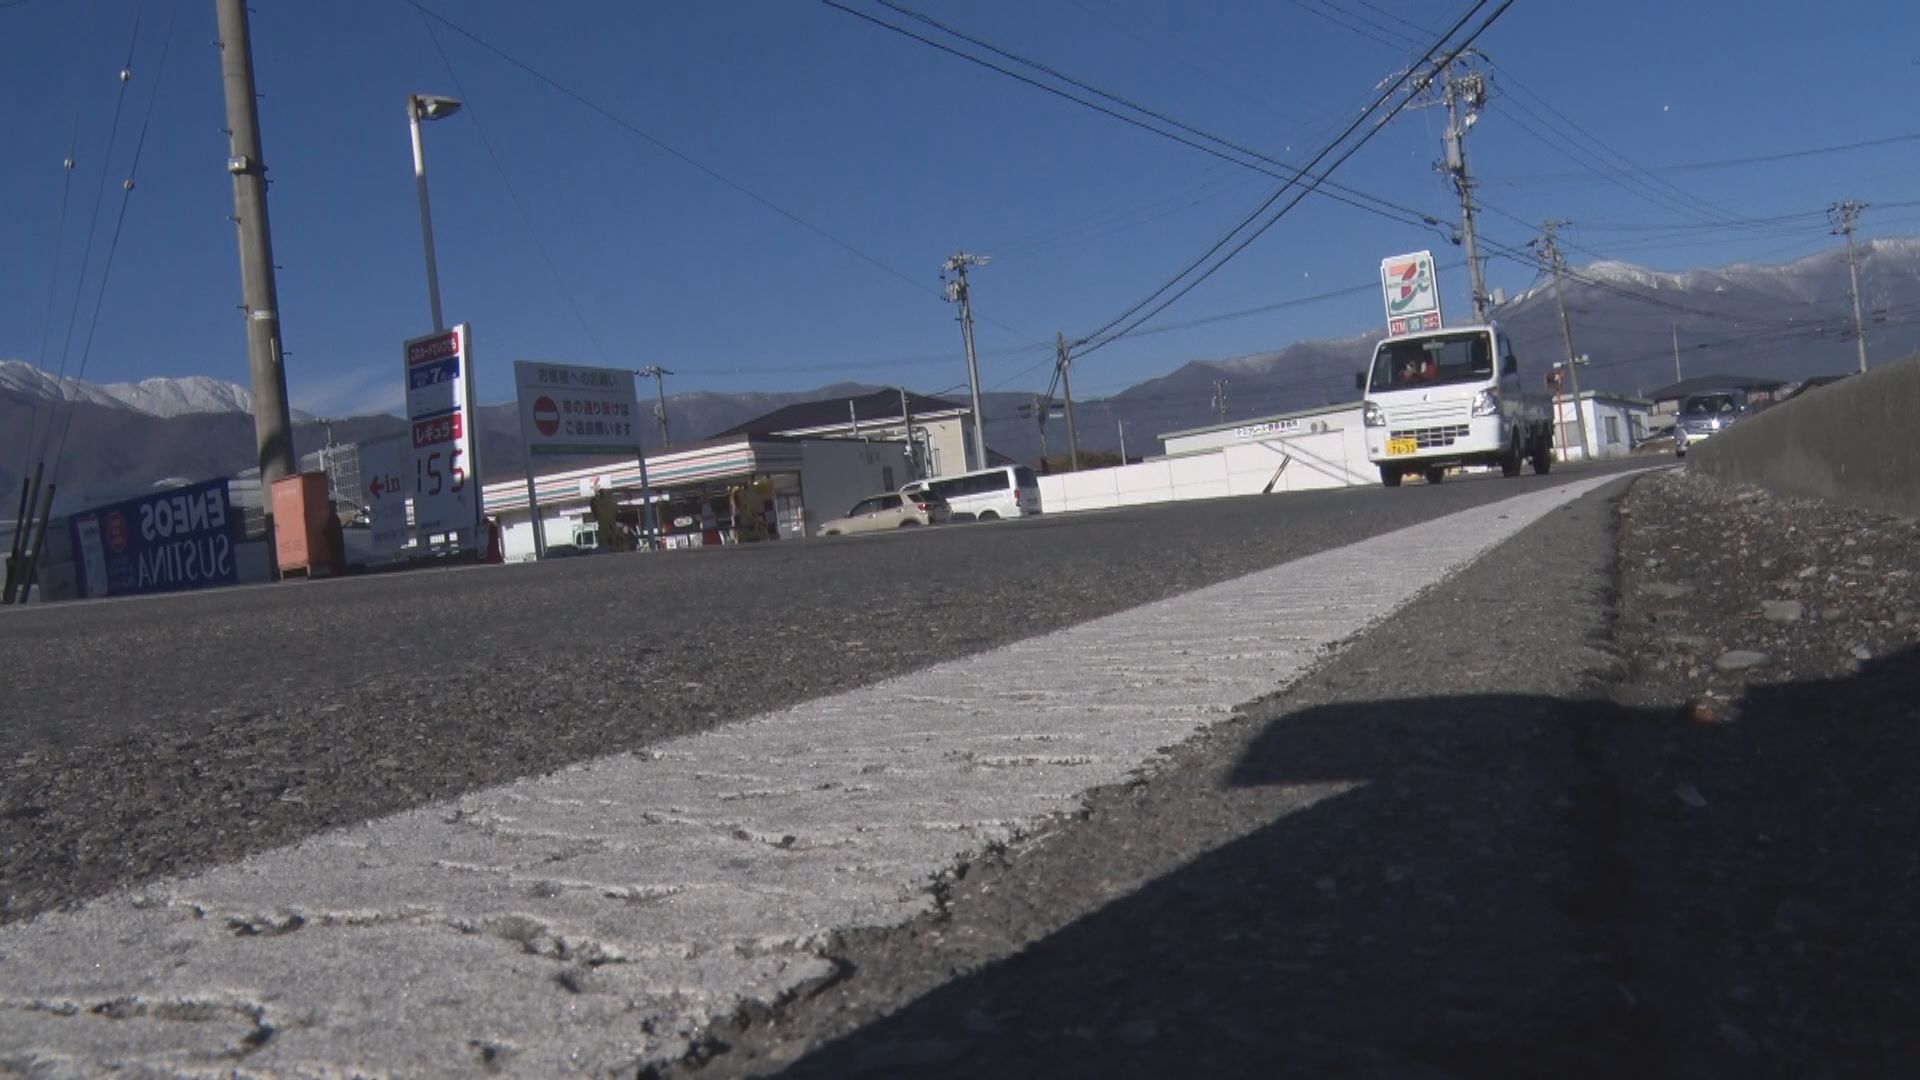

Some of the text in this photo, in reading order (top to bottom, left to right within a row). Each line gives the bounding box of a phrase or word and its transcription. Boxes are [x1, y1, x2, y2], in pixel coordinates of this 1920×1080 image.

[1391, 320, 1406, 334] ATM
[538, 367, 618, 387] お客様へのお願い
[562, 399, 630, 417] 車の通り抜けは
[415, 421, 459, 444] レギュラー
[565, 419, 632, 437] ご遠慮願います
[416, 447, 465, 496] 155
[384, 474, 401, 493] in
